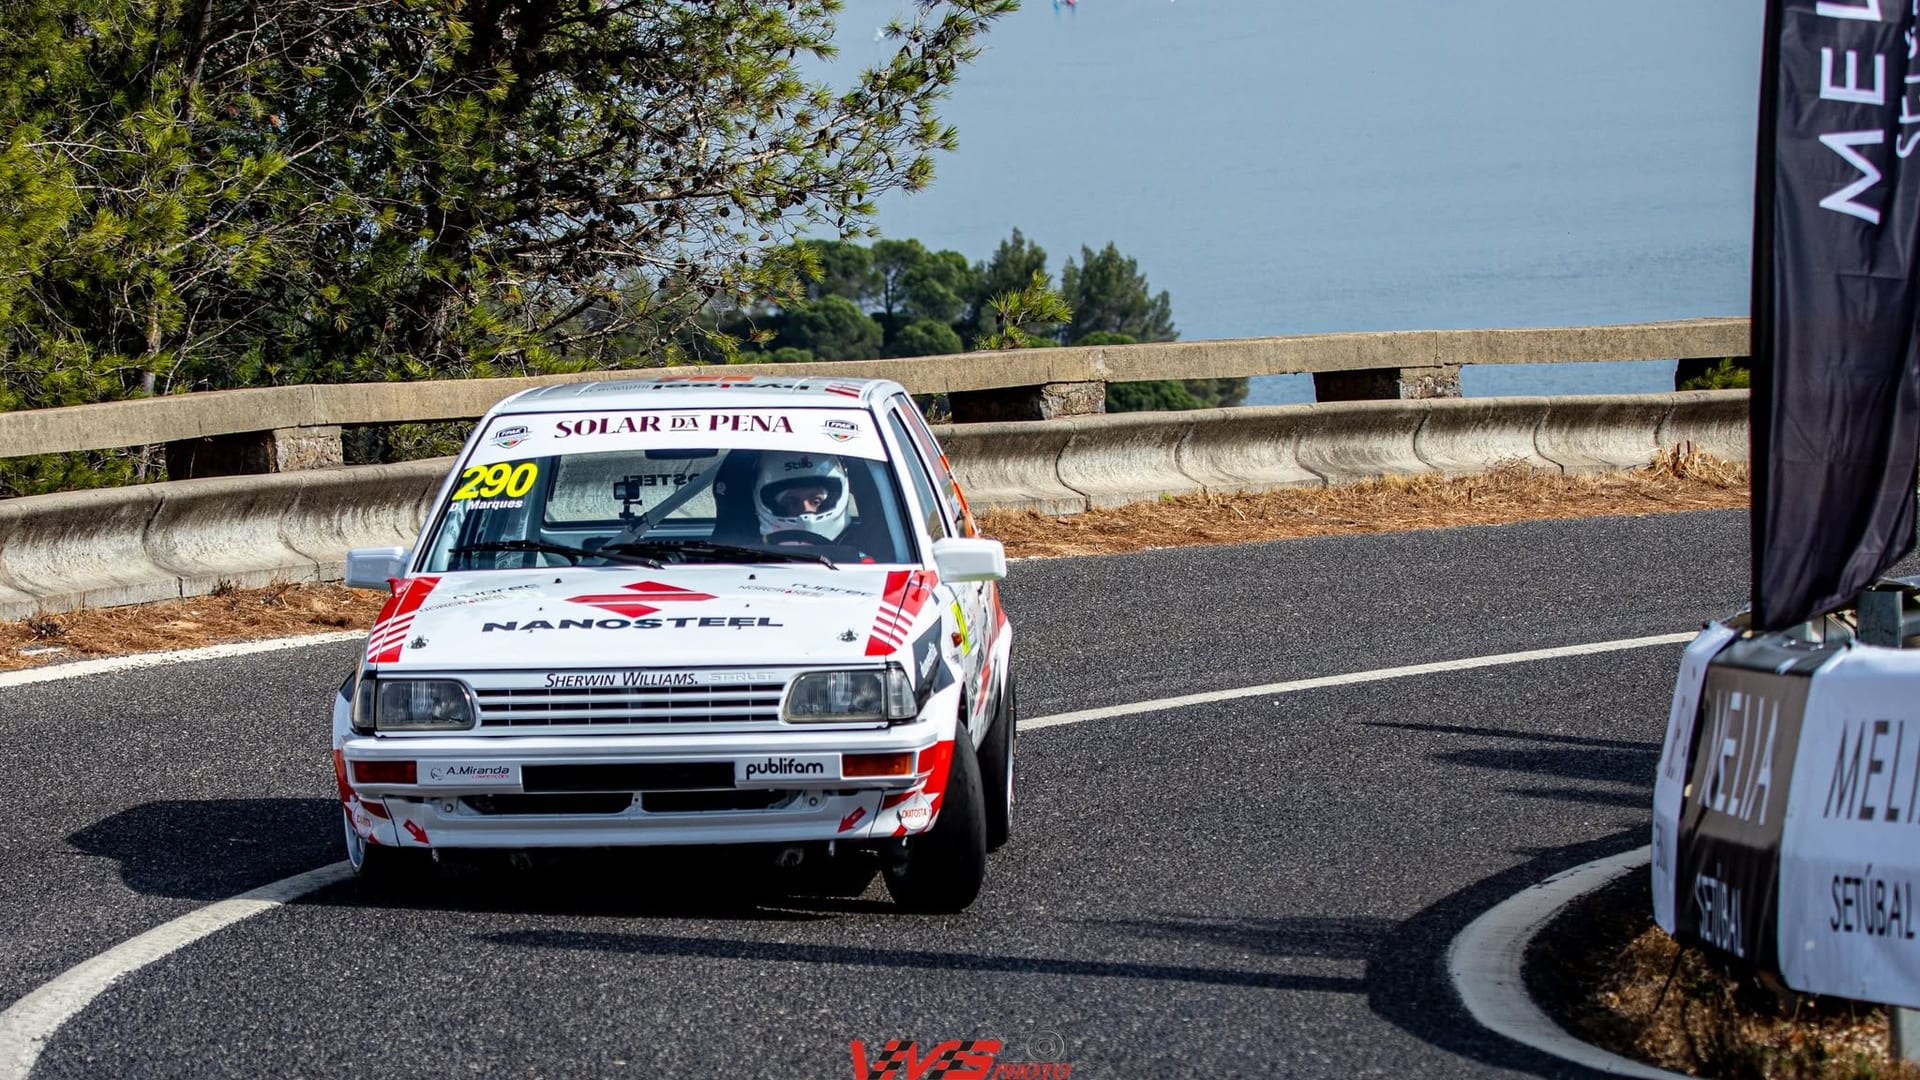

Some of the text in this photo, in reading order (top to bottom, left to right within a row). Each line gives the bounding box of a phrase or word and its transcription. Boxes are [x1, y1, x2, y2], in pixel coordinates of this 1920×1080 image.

[554, 415, 794, 438] SOLAR DA PENA
[452, 463, 538, 500] 290
[467, 500, 523, 511] Marques
[482, 617, 784, 632] NANOSTEEL
[545, 673, 615, 688] SHERWIN
[746, 757, 824, 780] publifam
[1830, 863, 1915, 940] SETÚBAL
